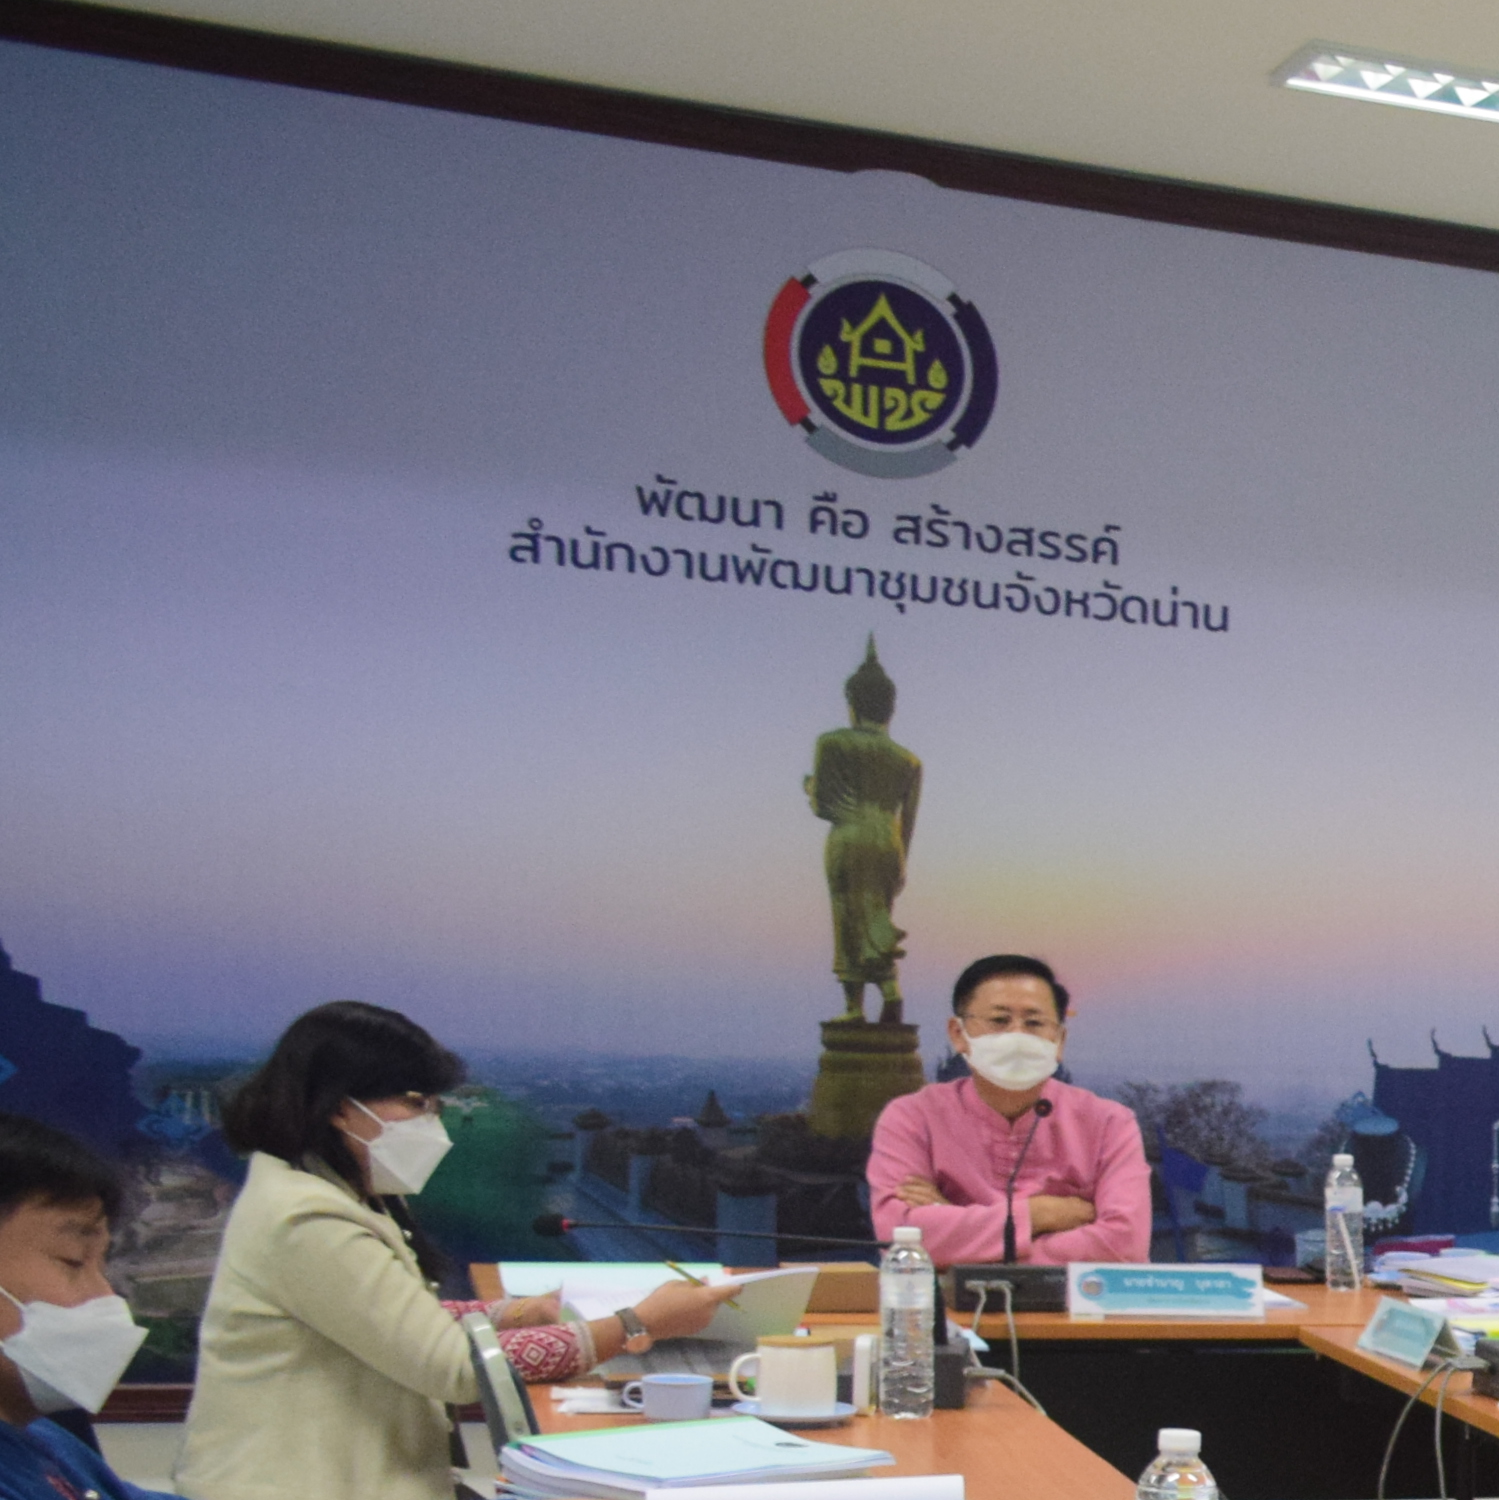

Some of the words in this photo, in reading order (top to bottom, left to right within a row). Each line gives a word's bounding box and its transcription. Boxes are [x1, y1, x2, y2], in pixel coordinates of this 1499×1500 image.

[635, 474, 785, 532] พัฒนา
[808, 490, 871, 540] คือ
[892, 502, 1122, 566] สร้างสรรค์
[507, 517, 1231, 634] สำนักงานพัฒนาชุมชนจังหวัดน่าน
